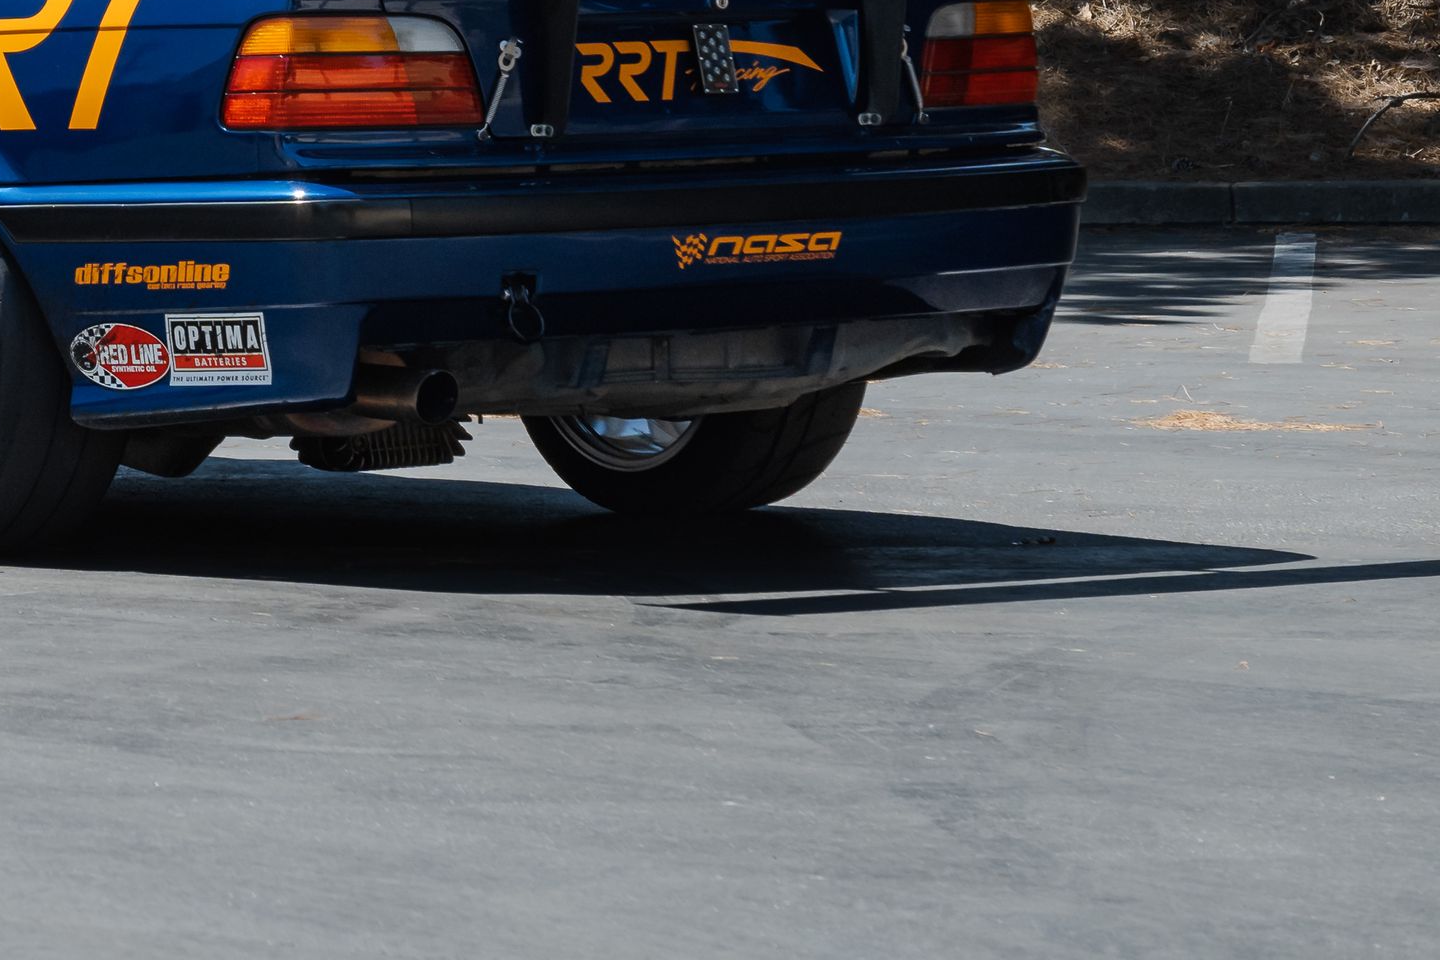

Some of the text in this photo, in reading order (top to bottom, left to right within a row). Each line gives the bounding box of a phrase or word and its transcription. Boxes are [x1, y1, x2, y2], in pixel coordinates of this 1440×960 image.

[575, 40, 690, 103] RRT
[707, 231, 842, 256] nasa
[75, 260, 230, 284] diffsonline
[173, 324, 260, 351] OPTIMA
[99, 344, 132, 366] RED
[194, 357, 248, 367] BATTERIES
